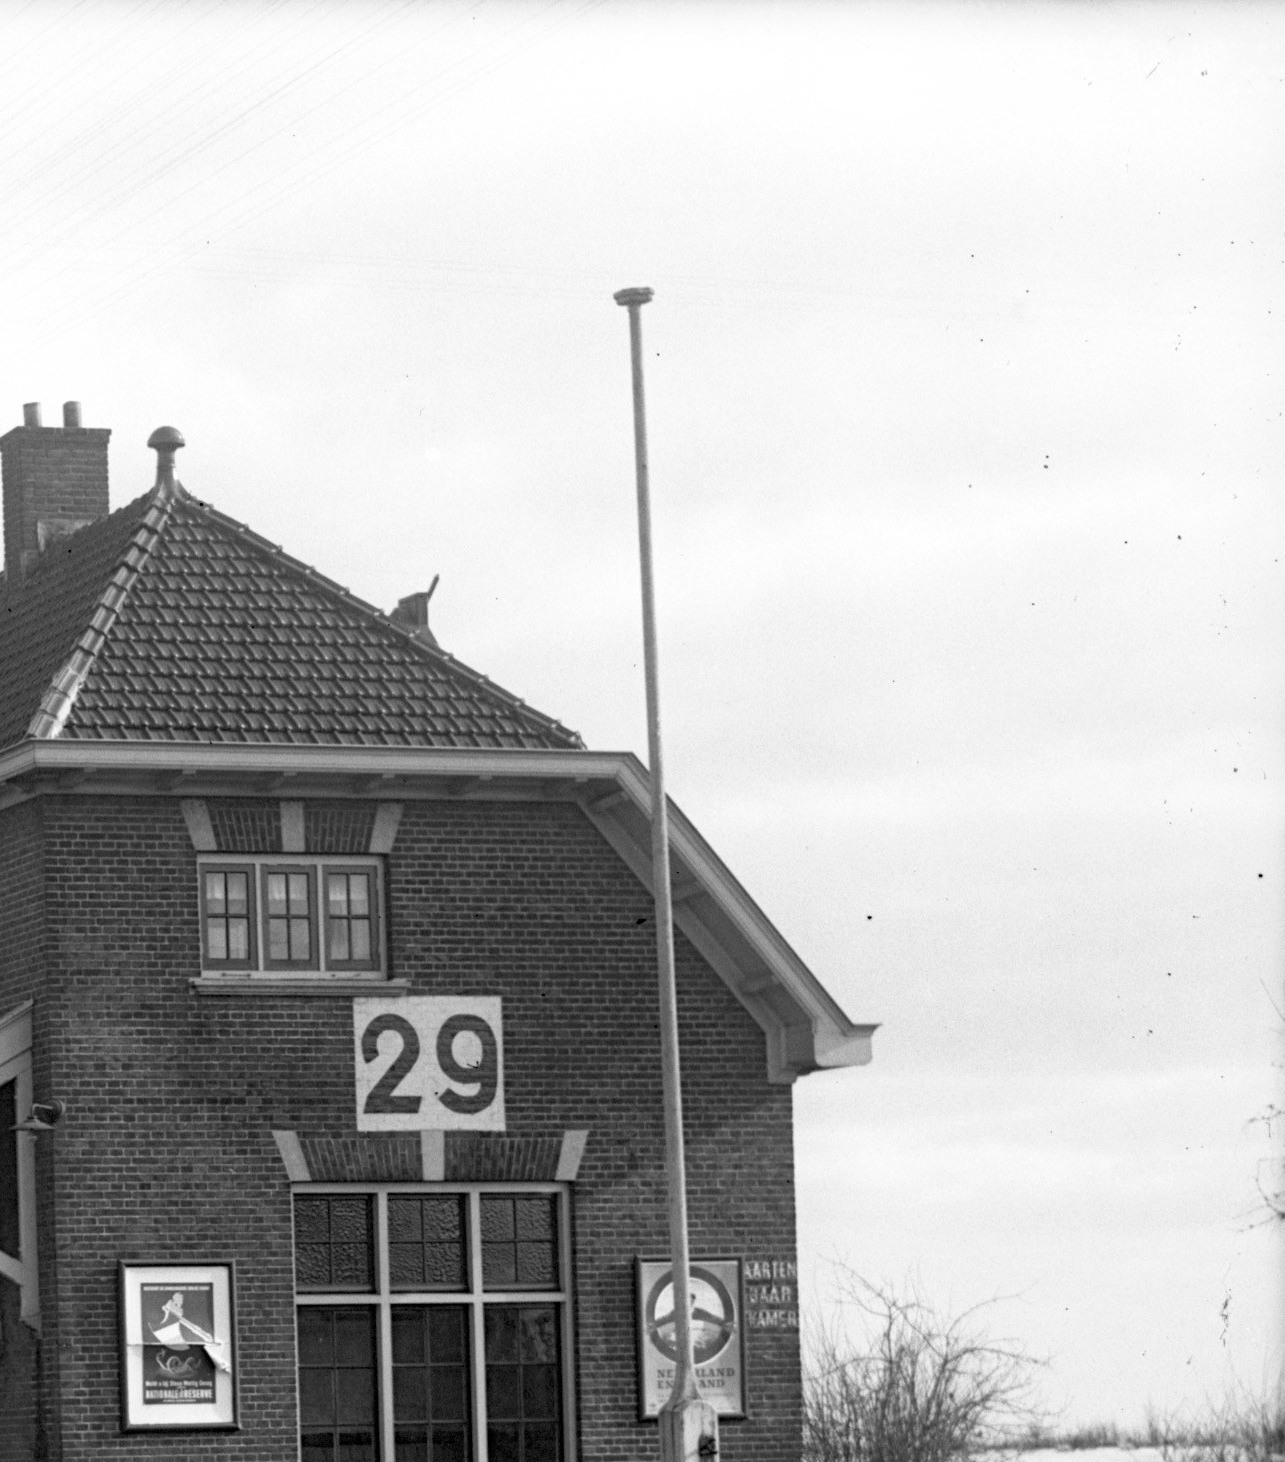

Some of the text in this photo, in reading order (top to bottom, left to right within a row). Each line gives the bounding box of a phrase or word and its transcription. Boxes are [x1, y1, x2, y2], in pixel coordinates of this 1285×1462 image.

[361, 1013, 498, 1115] 29
[744, 1261, 797, 1279] AARTEN
[745, 1310, 797, 1328] KAMER
[657, 1367, 735, 1378] NERLAND
